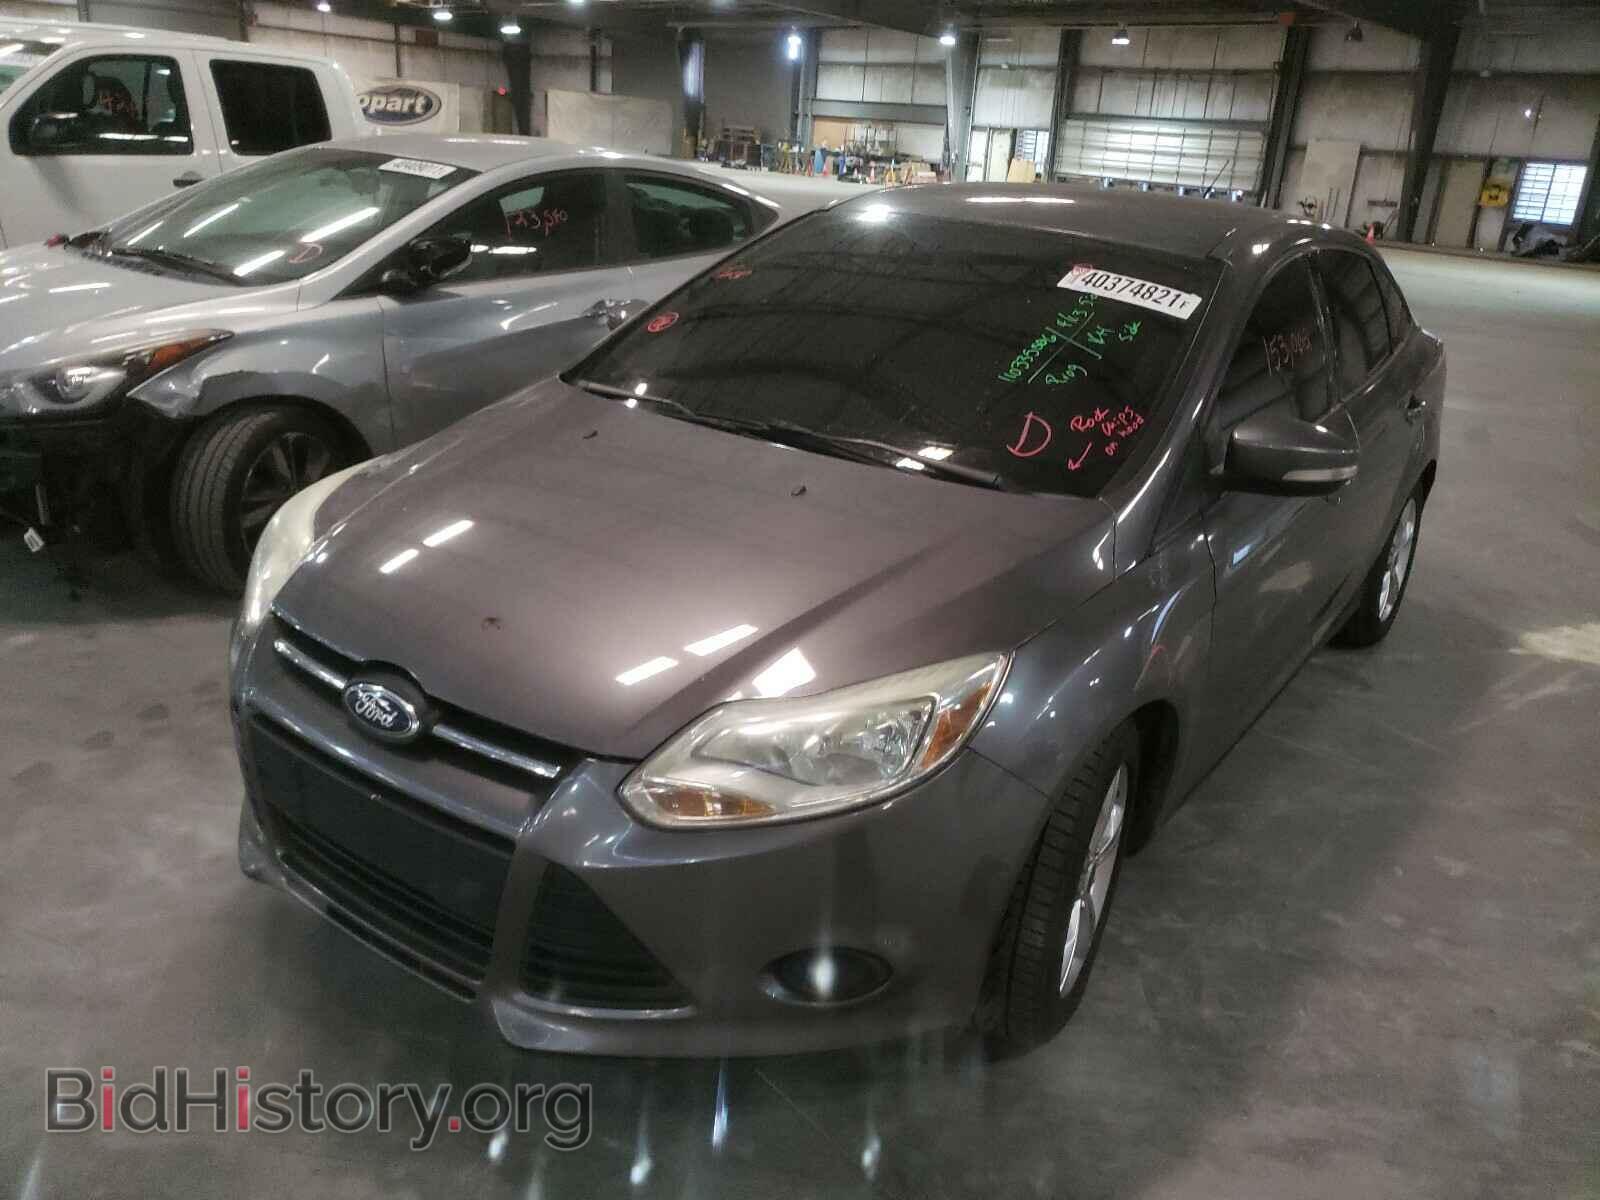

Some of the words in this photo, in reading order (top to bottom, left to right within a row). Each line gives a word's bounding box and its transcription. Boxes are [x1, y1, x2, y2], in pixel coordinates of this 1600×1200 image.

[359, 94, 427, 114] opart
[1081, 271, 1180, 308] 40374821
[1006, 410, 1053, 457] D
[355, 689, 398, 728] Ford
